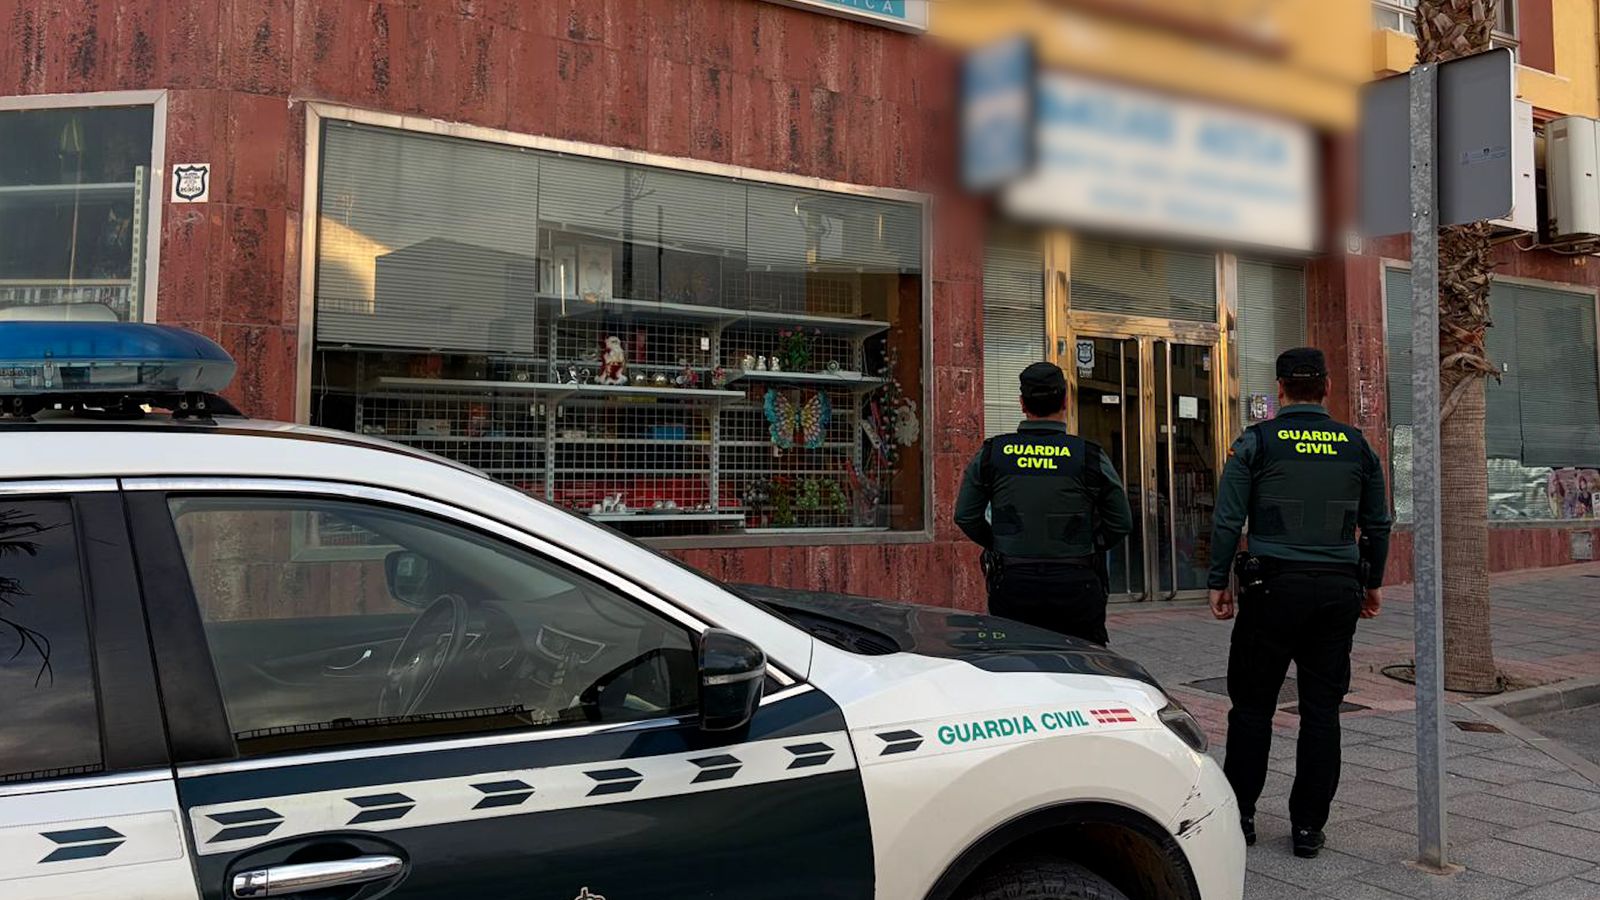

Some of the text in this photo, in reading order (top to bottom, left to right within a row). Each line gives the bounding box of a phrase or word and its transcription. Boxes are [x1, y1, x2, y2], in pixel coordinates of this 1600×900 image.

[1277, 430, 1349, 442] GUARDIA
[1003, 444, 1071, 457] GUARDIA
[1295, 442, 1338, 455] CIVIL
[1017, 457, 1058, 469] CIVIL
[937, 710, 1090, 746] GUARDIA CIVIL
